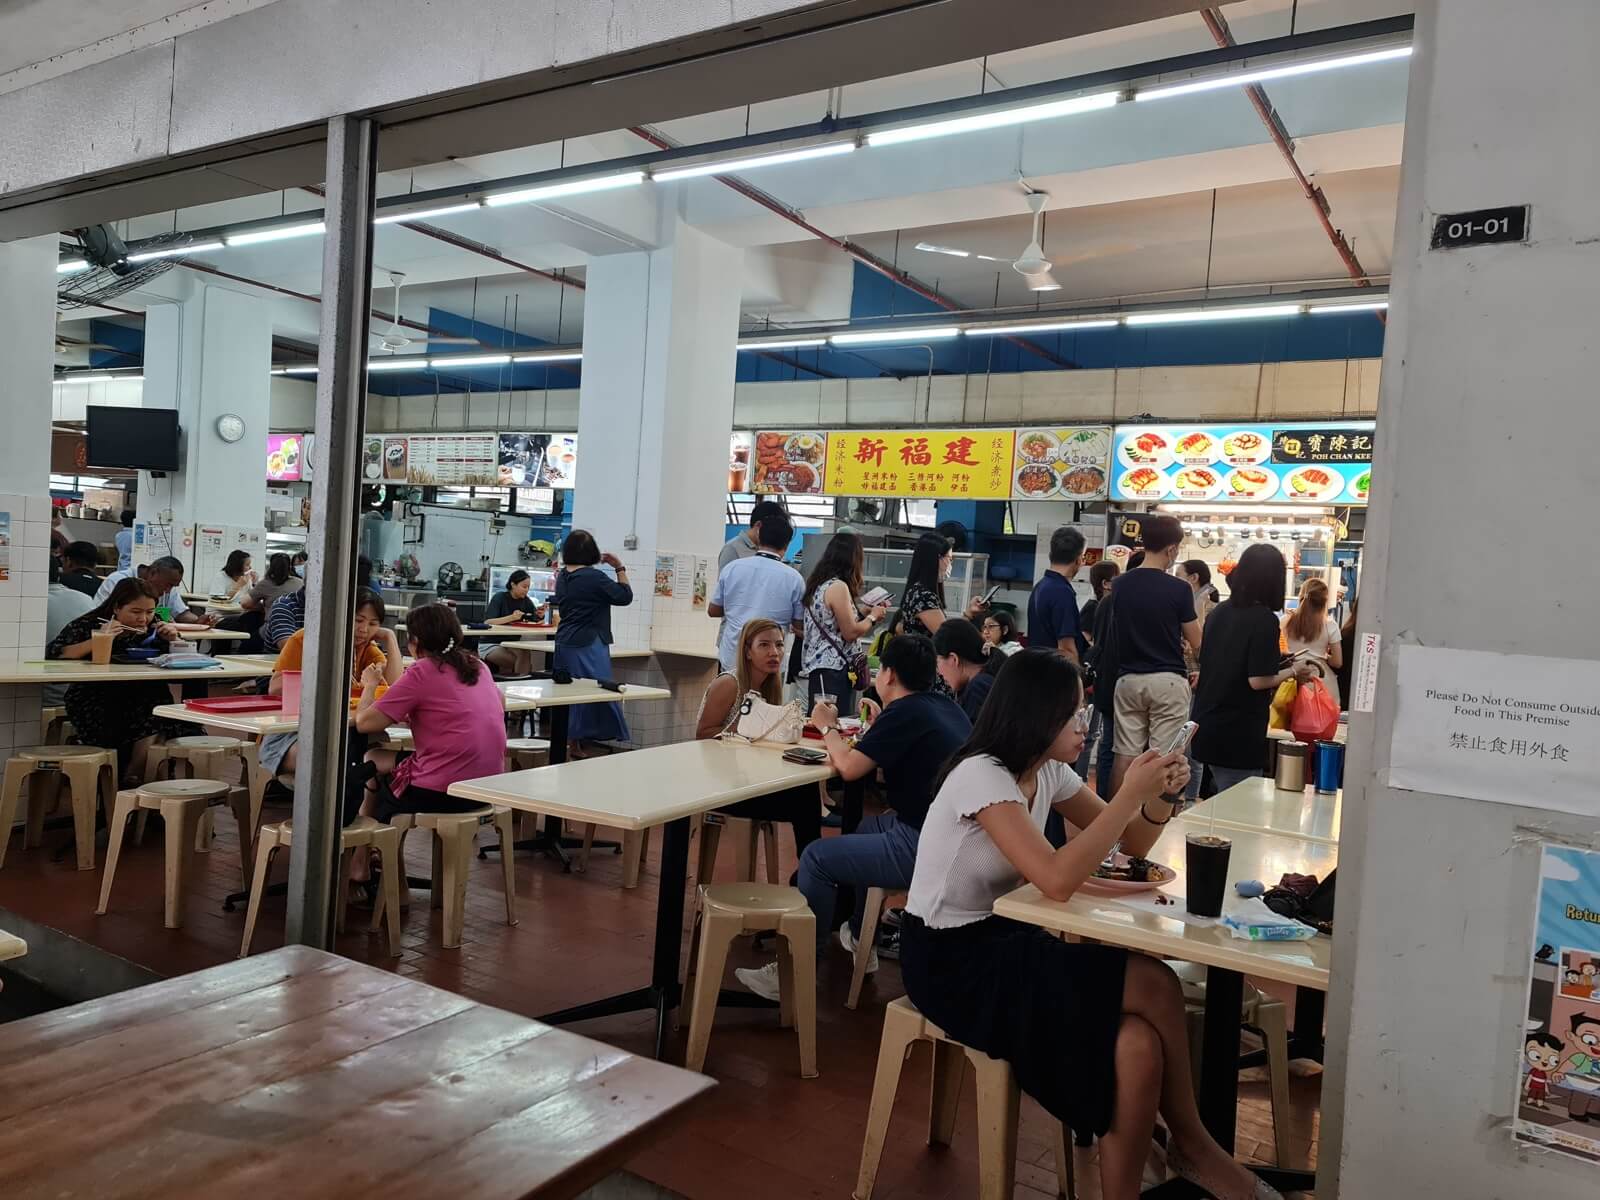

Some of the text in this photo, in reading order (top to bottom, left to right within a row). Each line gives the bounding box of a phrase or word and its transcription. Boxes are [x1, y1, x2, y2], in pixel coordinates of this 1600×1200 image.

[1448, 217, 1509, 239] 01-01
[853, 436, 980, 467] 新福建
[1307, 434, 1372, 452] 寶陳記
[1367, 635, 1377, 654] TKS
[1425, 689, 1458, 702] Please
[1462, 693, 1478, 704] Do
[1482, 695, 1502, 706] Not
[1505, 697, 1557, 712] Consume
[1454, 705, 1570, 727] Food in This Premise
[1449, 731, 1569, 762] 禁止食用外食
